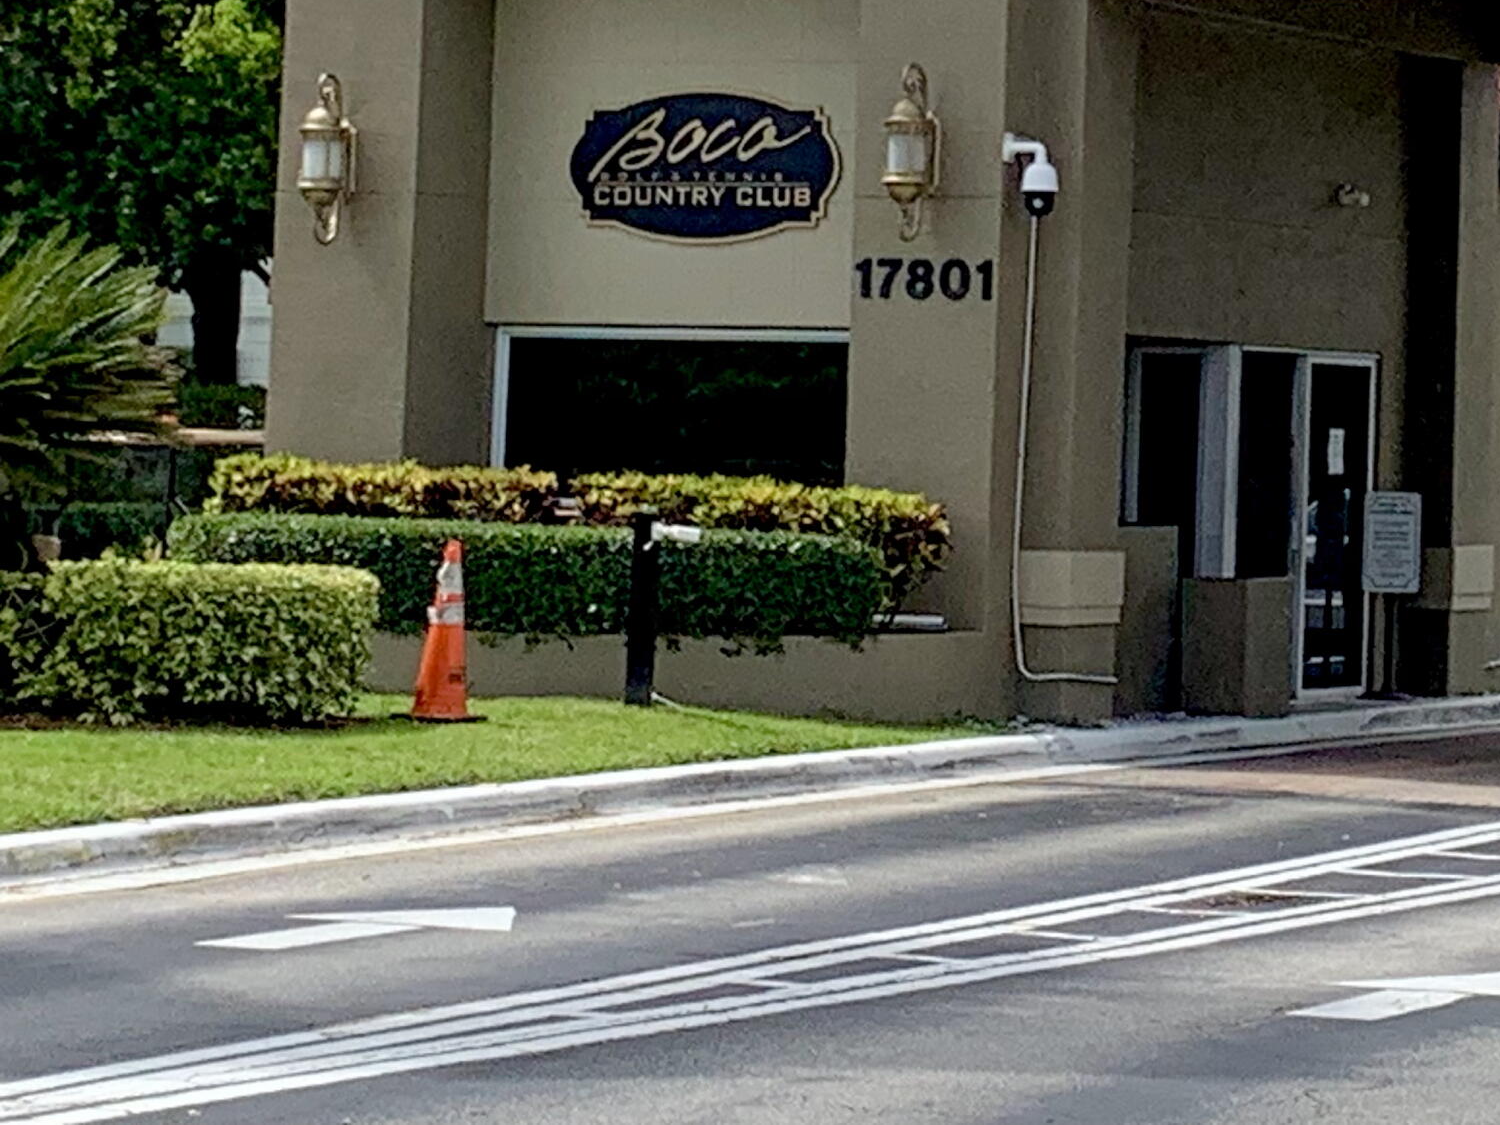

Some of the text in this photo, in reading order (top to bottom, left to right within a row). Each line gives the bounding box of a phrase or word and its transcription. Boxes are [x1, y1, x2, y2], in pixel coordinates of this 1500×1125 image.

[593, 186, 811, 208] COUNTRY CLUB
[855, 258, 993, 301] 17801
